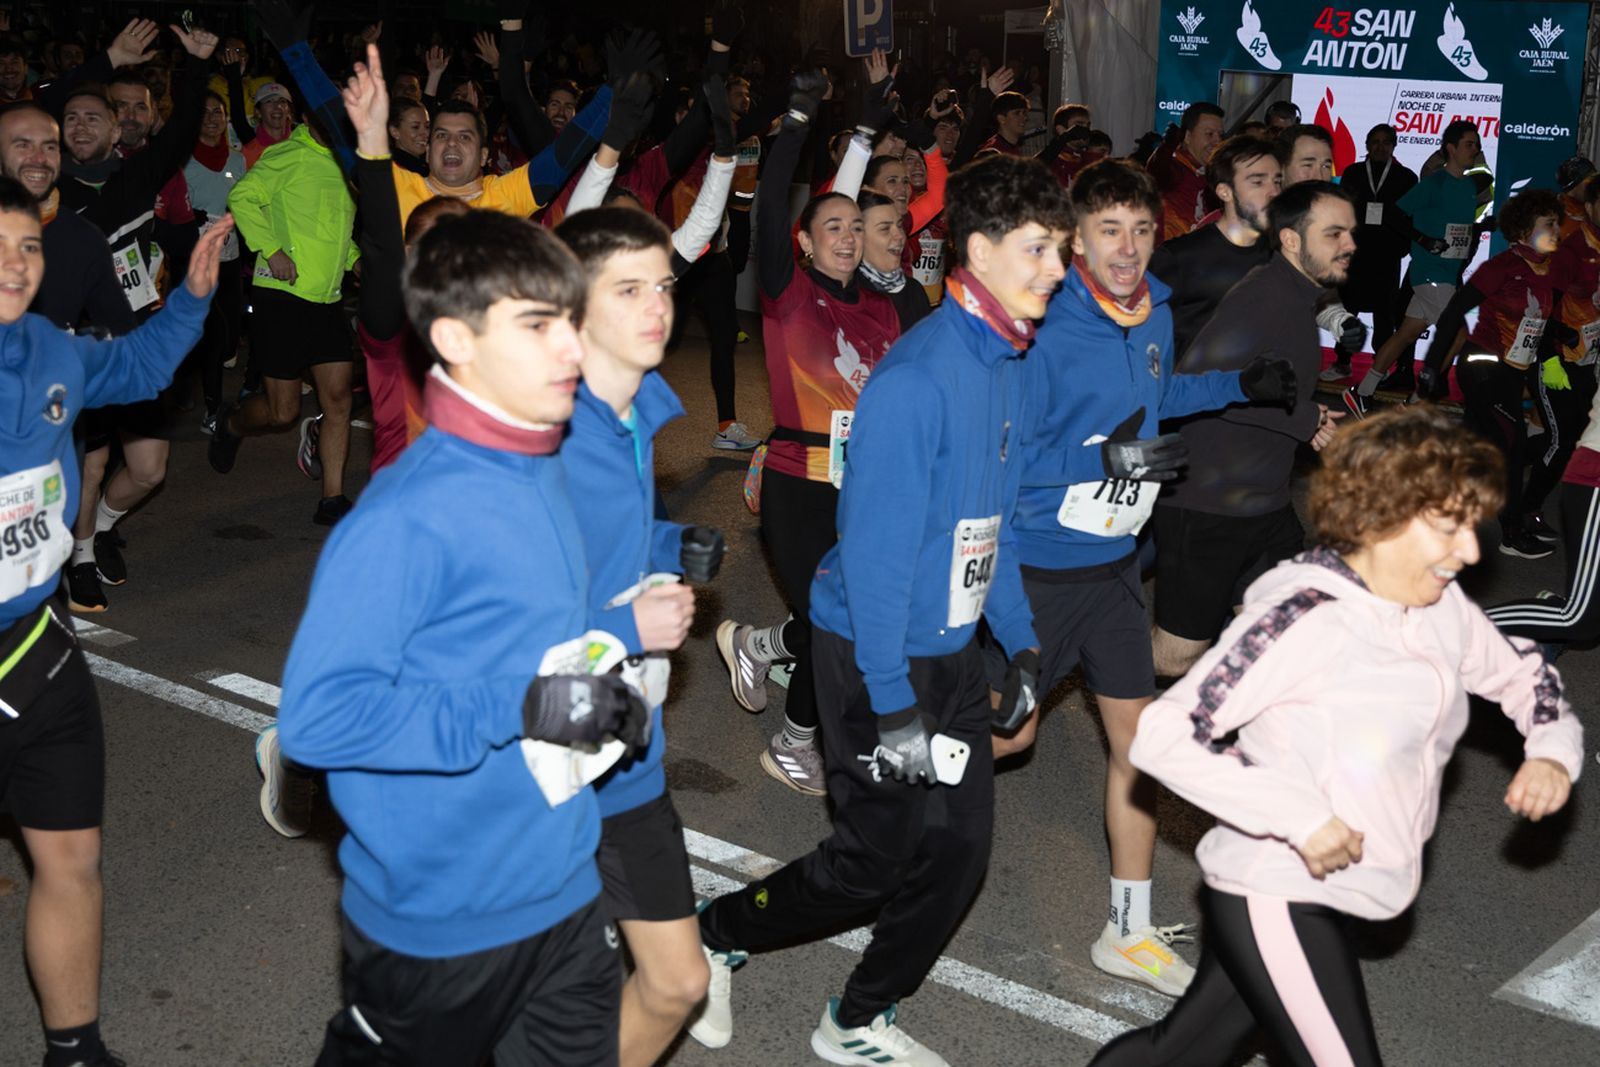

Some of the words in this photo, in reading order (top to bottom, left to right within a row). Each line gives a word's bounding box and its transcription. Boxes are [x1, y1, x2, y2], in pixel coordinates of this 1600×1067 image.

[1249, 37, 1268, 58] 43
[1301, 34, 1408, 71] ANTÓN
[1451, 45, 1472, 68] 43
[1541, 50, 1570, 60] RURAL
[1400, 90, 1435, 99] CARRERA
[1436, 92, 1467, 101] URBANA
[1398, 101, 1432, 112] NOCHE
[1432, 103, 1447, 112] DE
[1392, 111, 1443, 135] SAN
[1504, 123, 1570, 136] calderón
[1409, 136, 1435, 146] ENERO
[23, 488, 35, 502] DE
[1092, 478, 1141, 506] 7123
